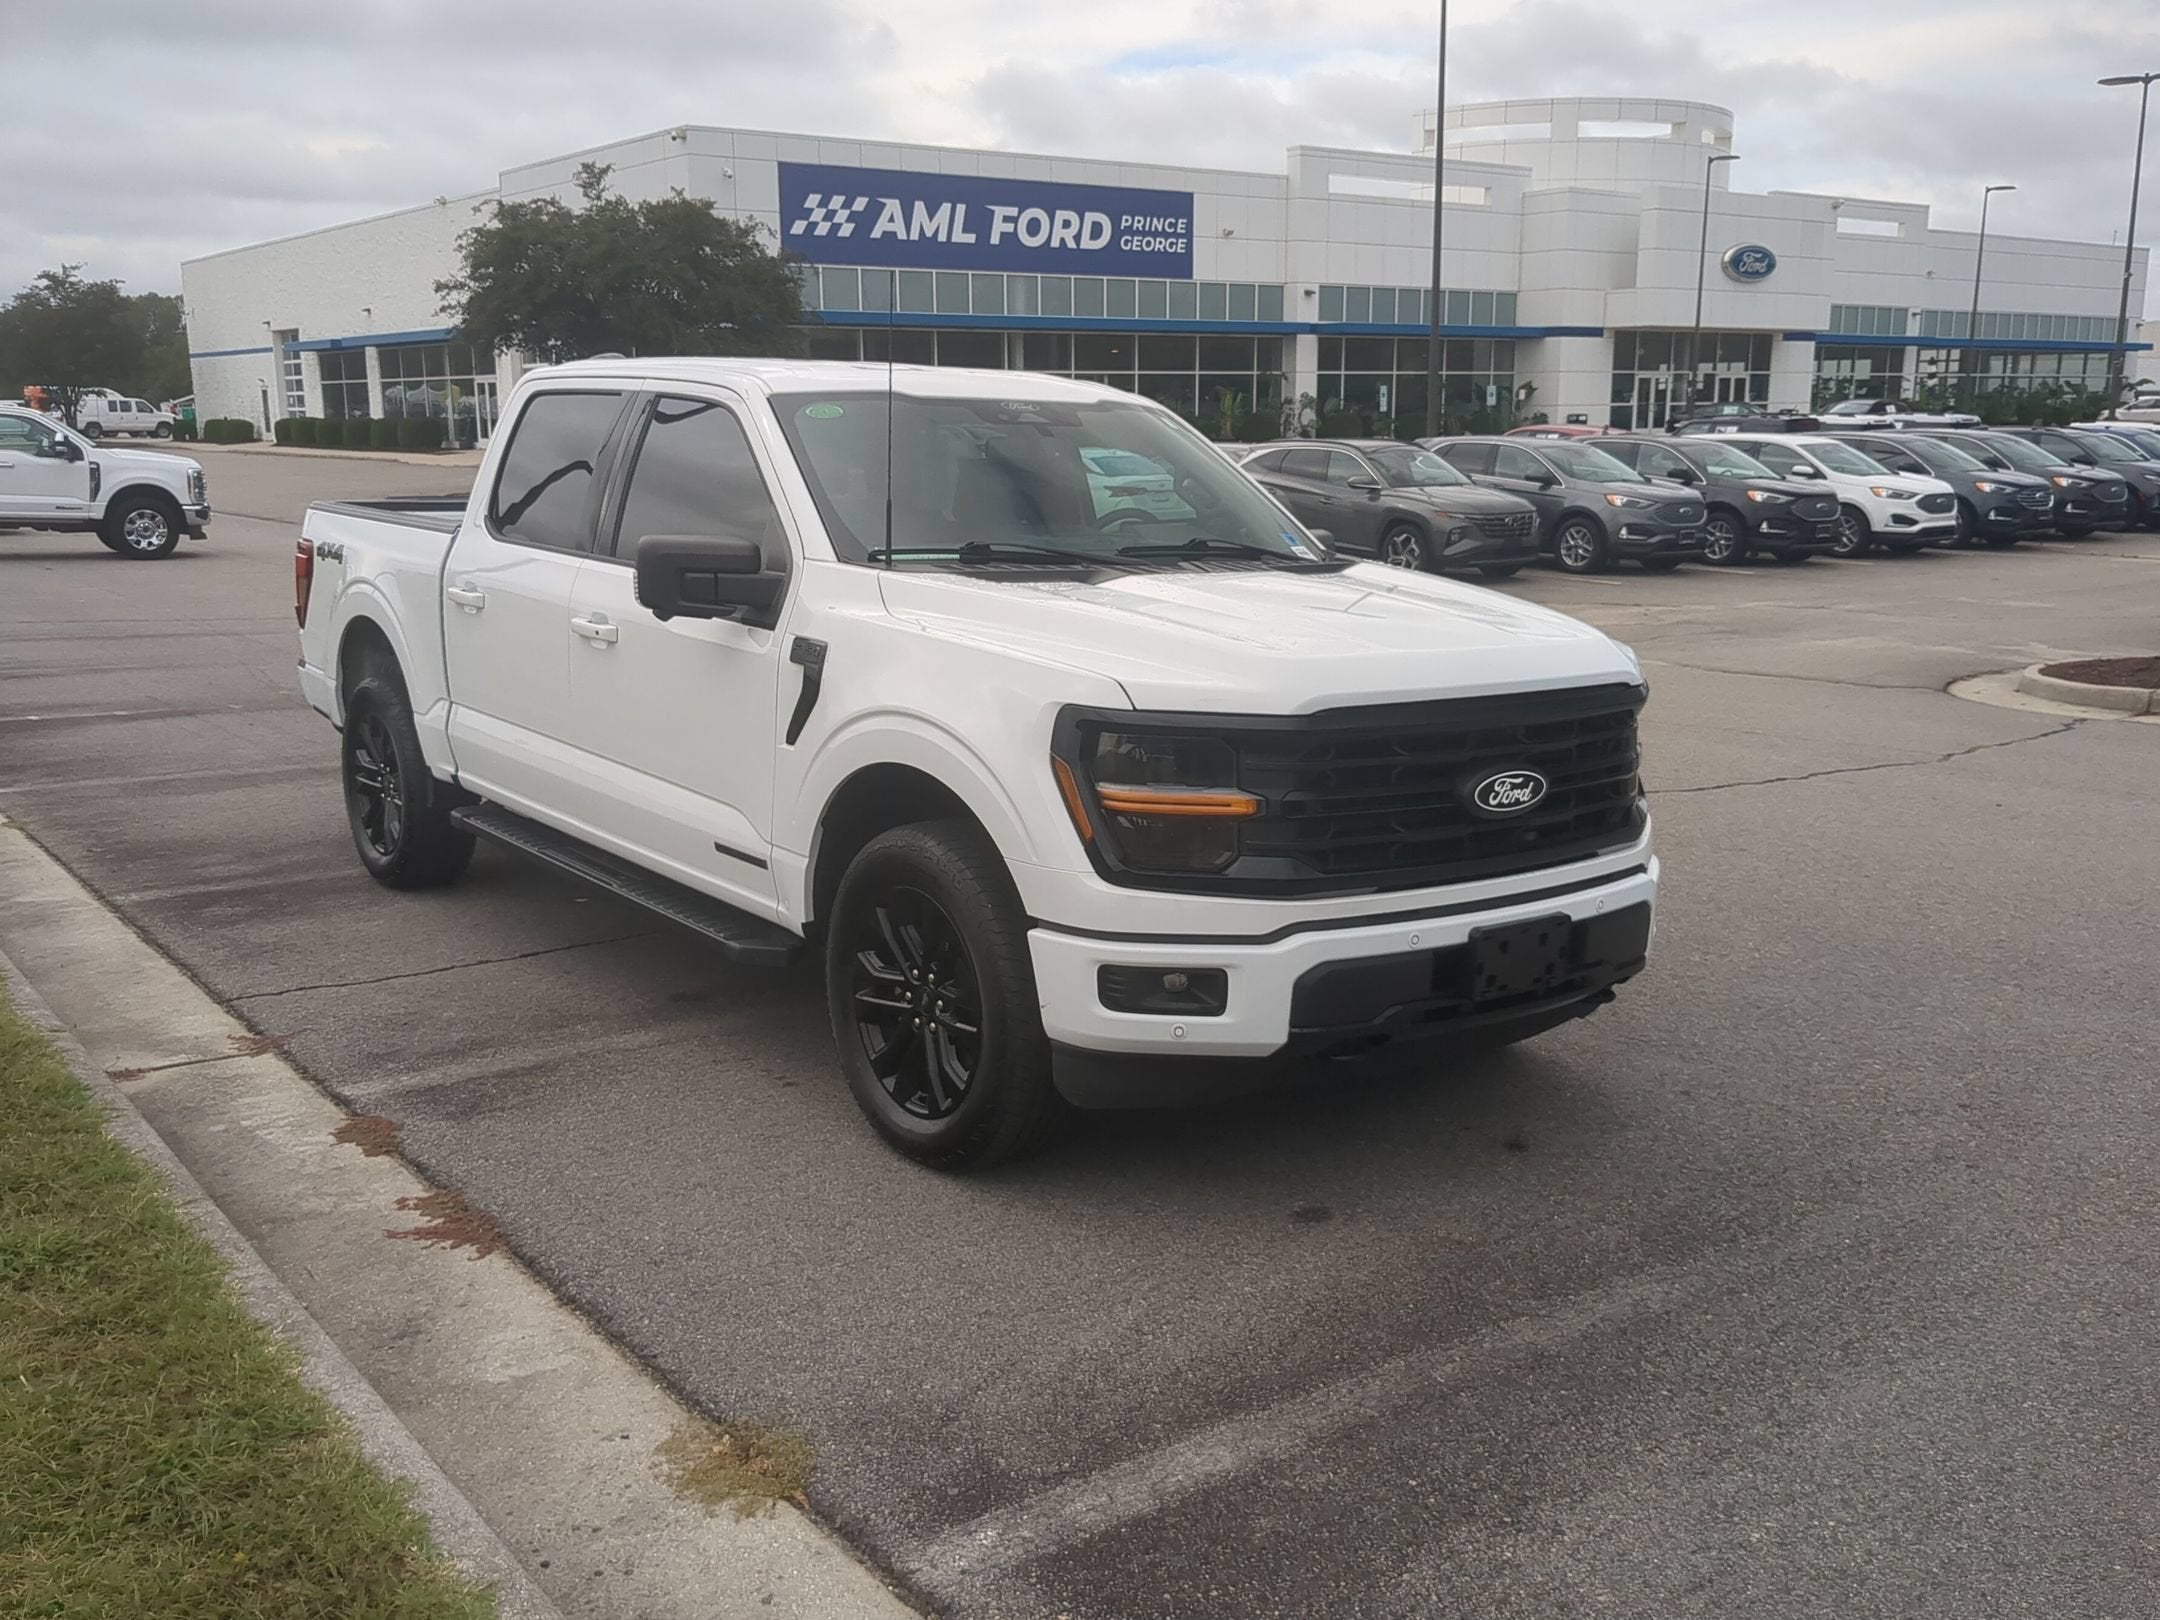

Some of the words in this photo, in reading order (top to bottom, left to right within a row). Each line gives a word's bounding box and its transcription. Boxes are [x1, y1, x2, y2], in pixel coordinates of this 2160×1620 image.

[870, 198, 977, 244] AML
[984, 205, 1112, 250] FORD
[1120, 215, 1187, 233] PRINCE
[1120, 235, 1187, 253] GEORGE
[1739, 251, 1769, 272] Ford
[1489, 777, 1534, 806] Ford
